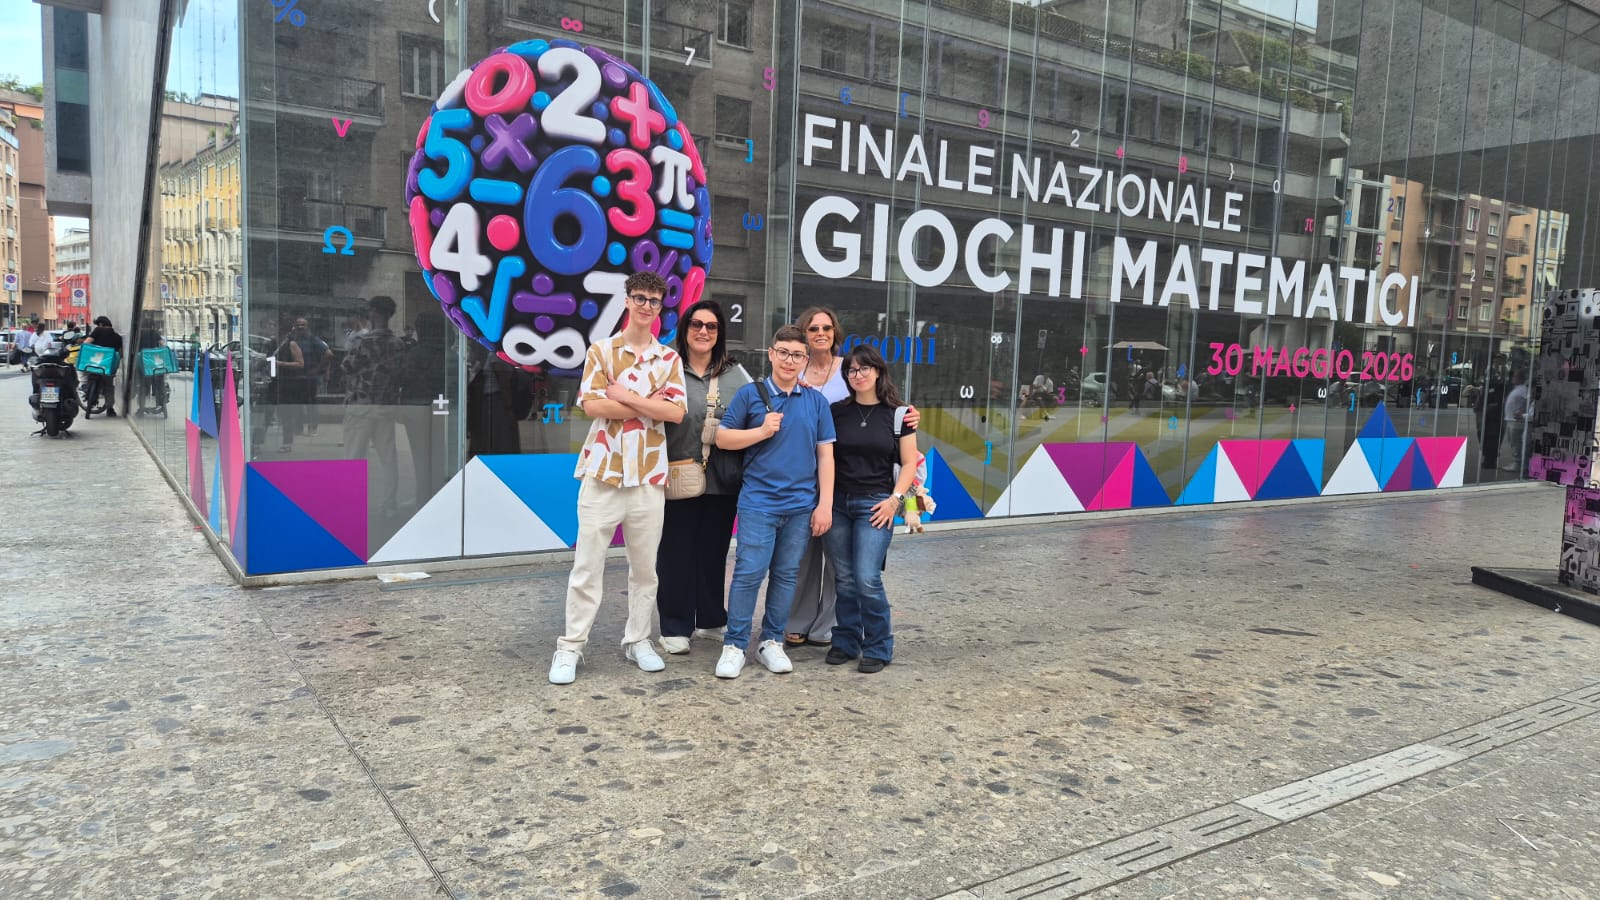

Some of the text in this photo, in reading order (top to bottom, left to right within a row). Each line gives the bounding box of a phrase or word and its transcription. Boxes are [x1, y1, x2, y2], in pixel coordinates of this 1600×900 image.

[537, 47, 607, 143] 2
[763, 67, 777, 91] 5
[417, 109, 474, 200] 5
[1070, 129, 1080, 148] 2
[606, 148, 655, 236] 3
[652, 145, 695, 210] π
[803, 113, 1243, 232] FINALE NAZIONALE
[322, 225, 355, 256] Ω
[523, 145, 607, 275] 6
[430, 202, 491, 291] 4
[800, 195, 1419, 327] GIOCHI MATEMATICI
[730, 304, 743, 323] 2
[266, 356, 277, 377] 1
[1207, 342, 1414, 381] 30 MAGGIO 2026
[542, 403, 564, 424] π
